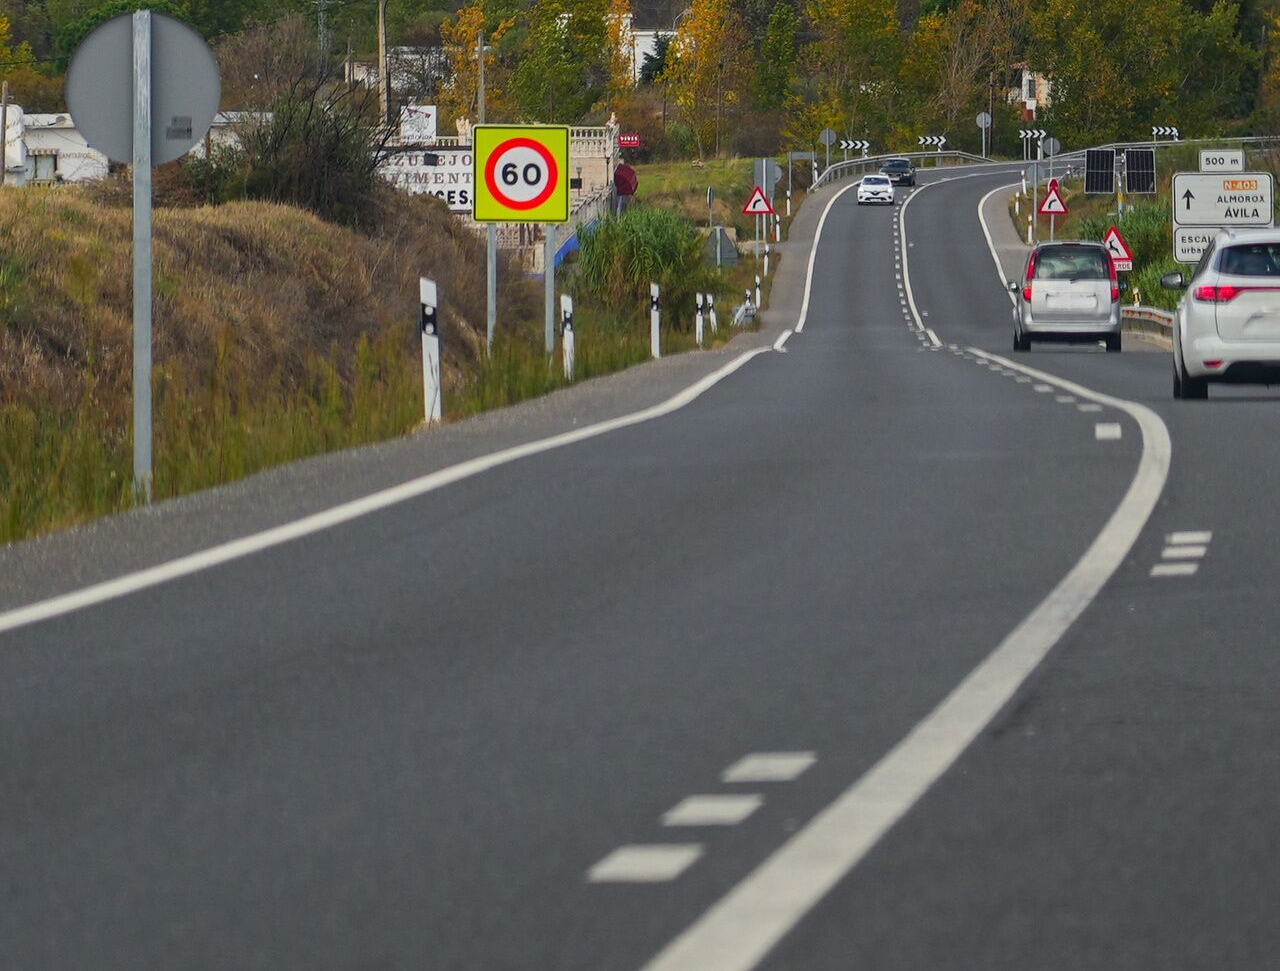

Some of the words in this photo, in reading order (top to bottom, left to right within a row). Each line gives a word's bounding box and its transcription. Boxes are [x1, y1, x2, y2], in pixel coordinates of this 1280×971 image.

[1205, 157, 1225, 165] 500
[502, 162, 541, 185] 60
[1224, 181, 1257, 190] N-403
[1217, 195, 1265, 203] ALMOROX
[1225, 207, 1259, 218] ÁVILA
